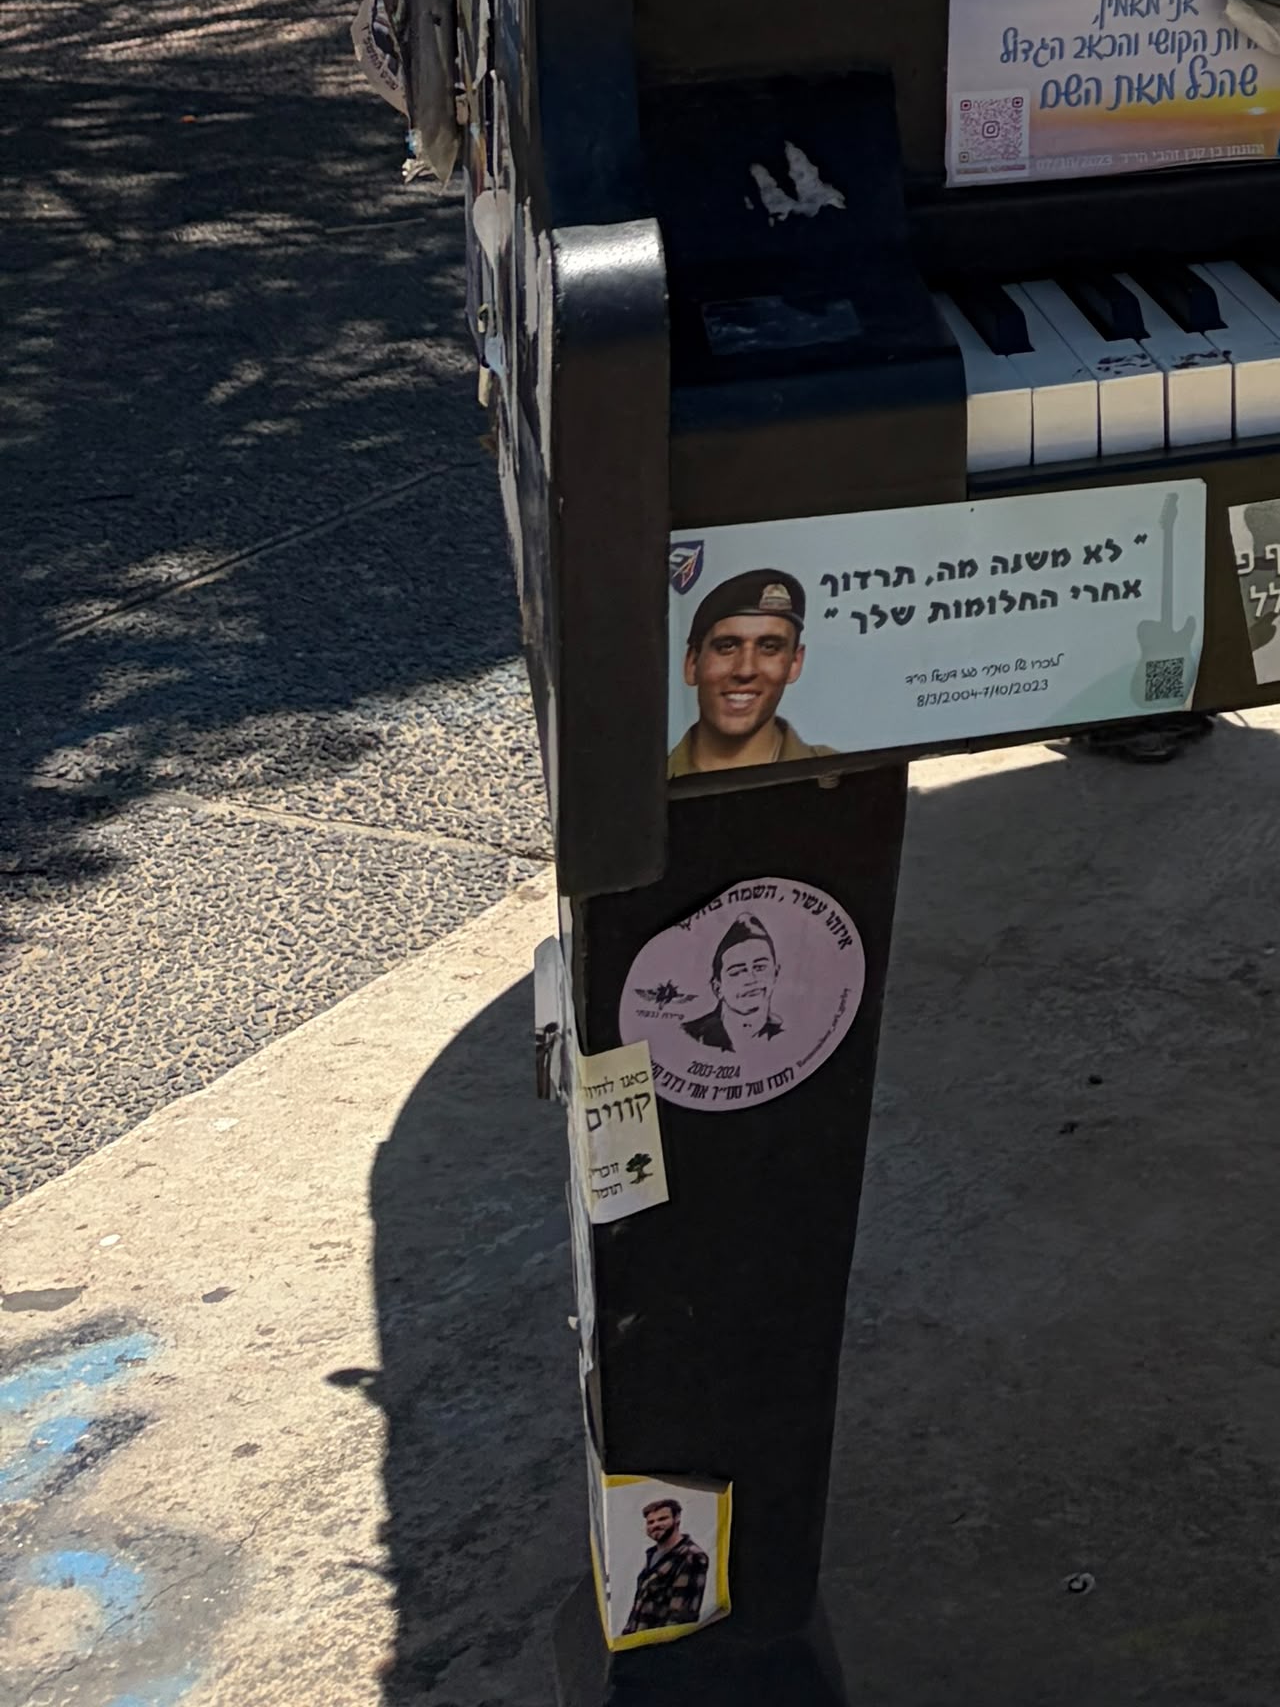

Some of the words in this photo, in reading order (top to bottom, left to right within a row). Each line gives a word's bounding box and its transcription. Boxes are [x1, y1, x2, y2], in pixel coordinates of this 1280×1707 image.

[991, 548, 1071, 575] משנה
[1083, 538, 1122, 565] לא
[820, 566, 915, 597] תרדוף
[925, 559, 978, 586] מה,
[1070, 579, 1142, 603] אחרי
[851, 605, 915, 634] שלך
[928, 589, 1058, 624] החלומות
[917, 679, 1048, 707] 8/3/2004-7/10/2023
